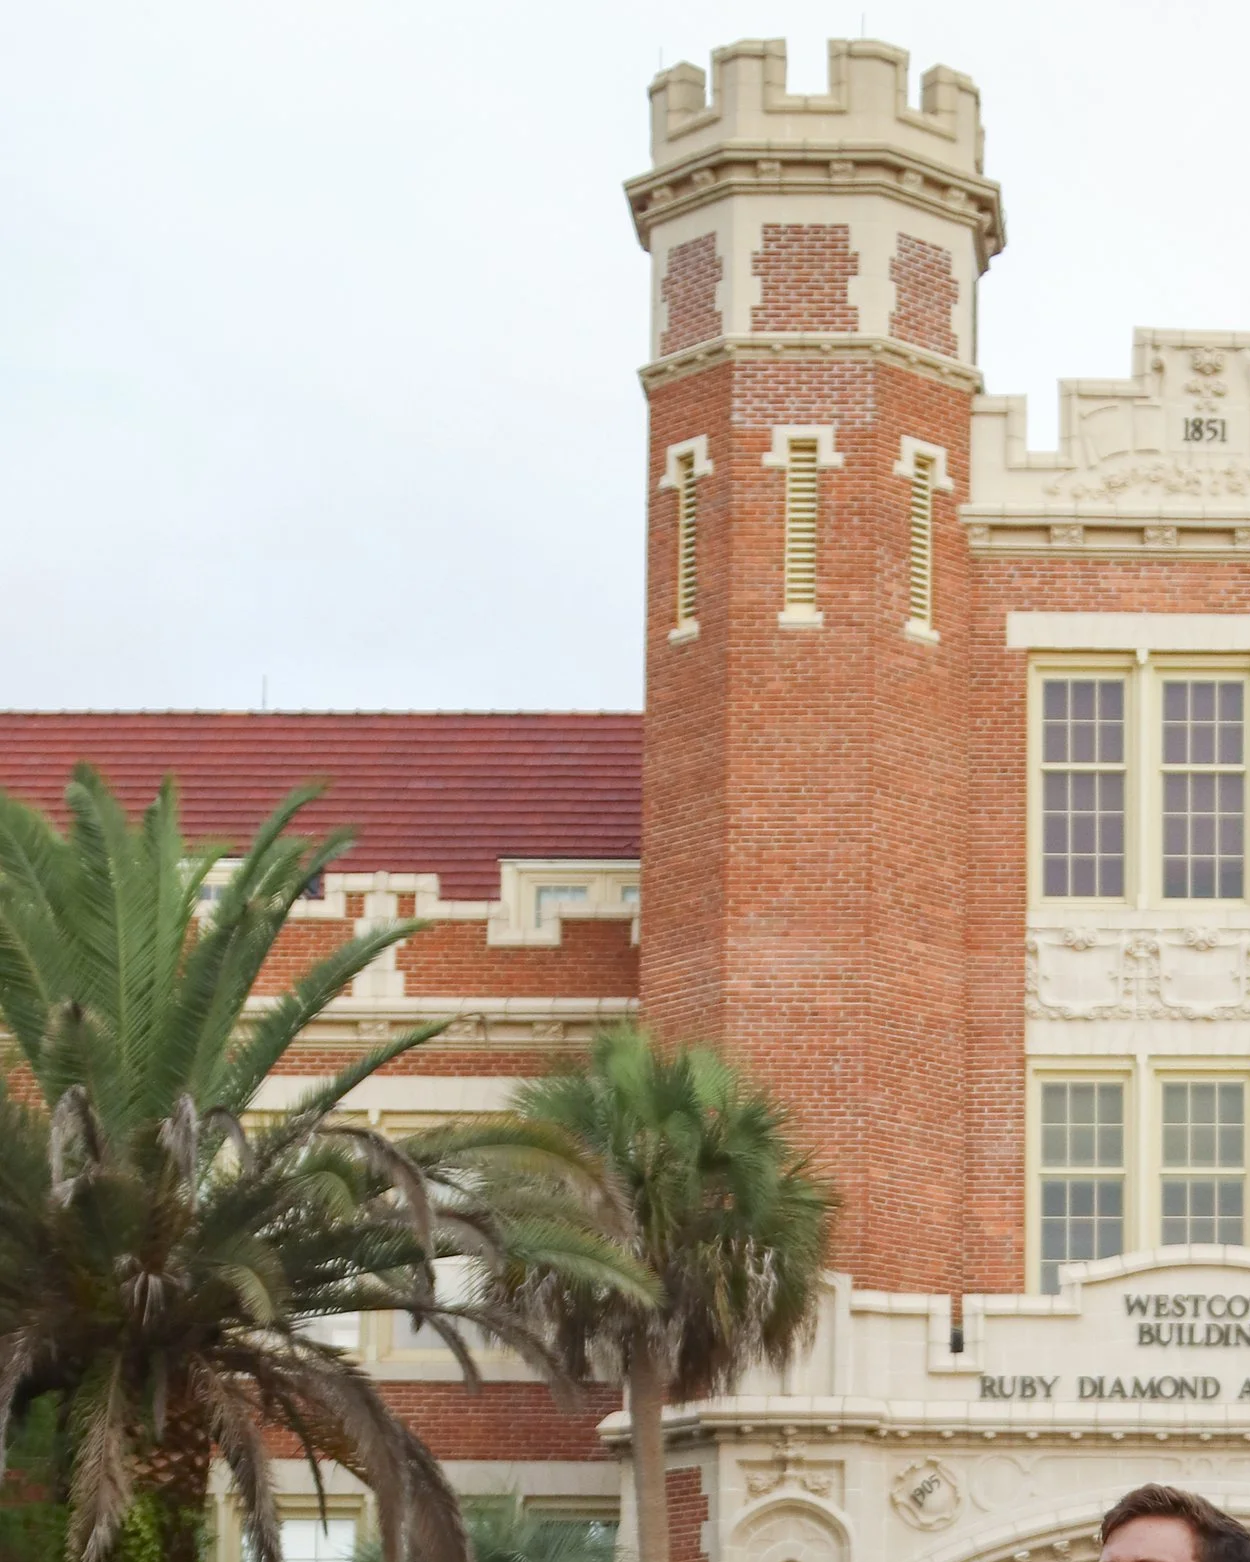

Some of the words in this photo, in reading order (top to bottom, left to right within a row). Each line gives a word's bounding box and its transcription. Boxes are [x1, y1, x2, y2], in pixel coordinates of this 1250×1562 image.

[1183, 417, 1227, 442] 1851
[979, 1376, 1061, 1399] RUBY
[1078, 1376, 1221, 1400] DIAMOND
[909, 1473, 941, 1508] 1905
